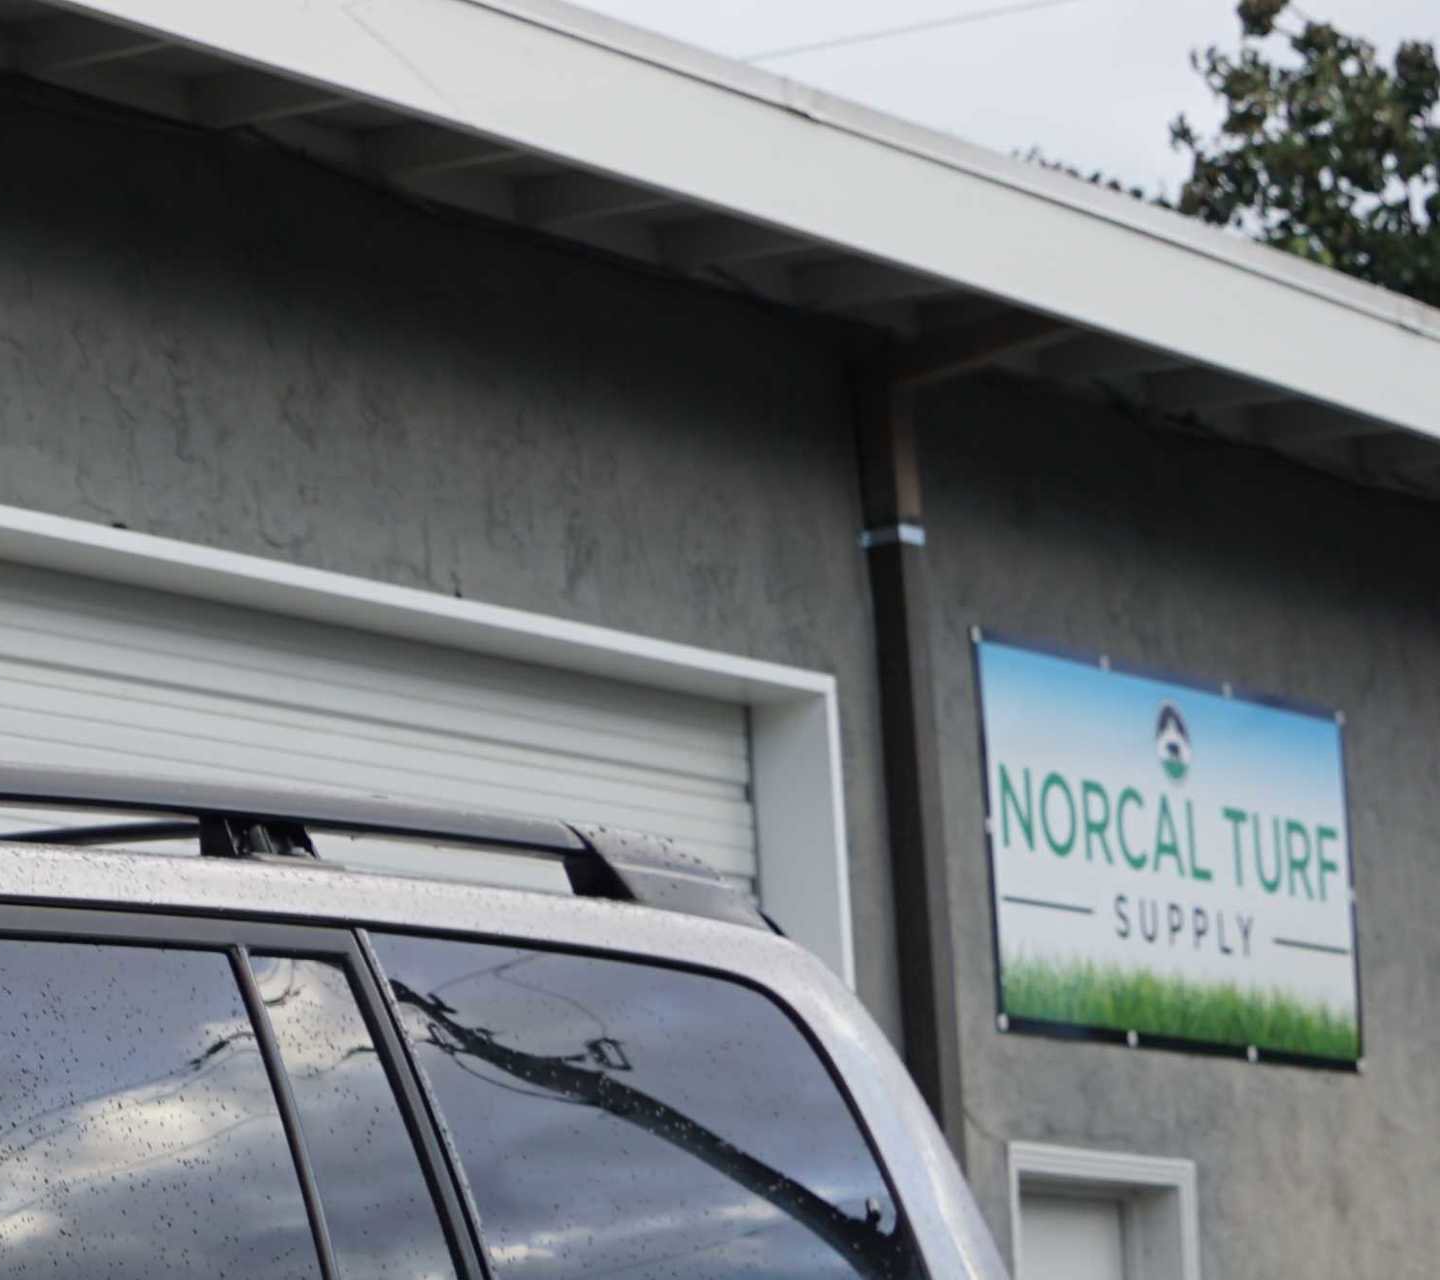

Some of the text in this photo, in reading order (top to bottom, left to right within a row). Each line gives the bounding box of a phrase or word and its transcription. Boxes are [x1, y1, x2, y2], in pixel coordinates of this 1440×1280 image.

[997, 762, 1339, 902] NORCAL TURF
[1113, 893, 1254, 957] SUPPLY
